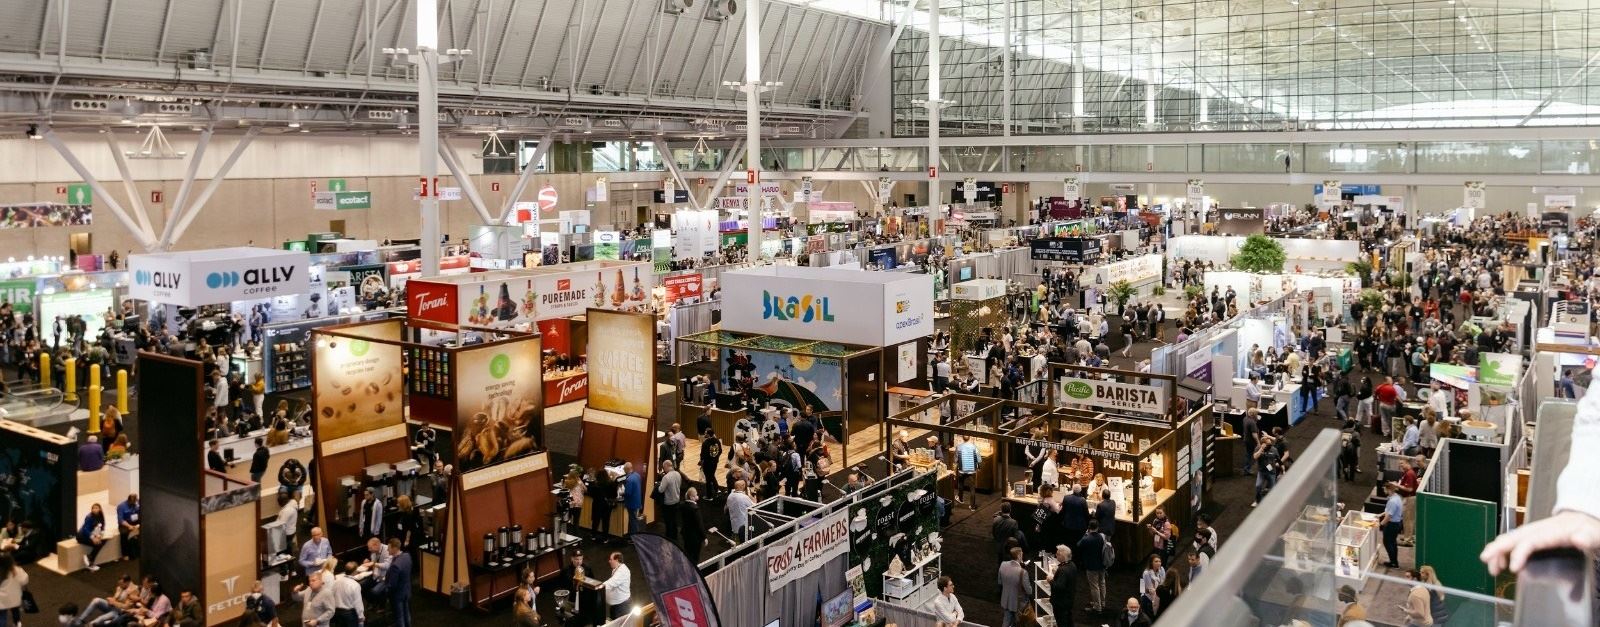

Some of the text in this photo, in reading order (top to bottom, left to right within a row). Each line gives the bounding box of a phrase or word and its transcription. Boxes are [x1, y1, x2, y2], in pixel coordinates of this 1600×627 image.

[340, 196, 368, 204] ecotact
[350, 268, 382, 282] ARISTA
[416, 292, 448, 316] Torani
[543, 290, 585, 304] PUREMADE
[556, 377, 587, 403] Toran
[1067, 382, 1090, 394] Pacific
[1097, 385, 1157, 404] BARISTA
[1112, 400, 1141, 408] SERIES
[1016, 438, 1120, 459] BARISTA INSPIRED BARISTA APPROVED
[920, 492, 935, 504] roast
[878, 512, 894, 525] roast
[768, 546, 793, 574] FOOD
[795, 542, 802, 561] 4
[803, 518, 848, 557] FARMERS
